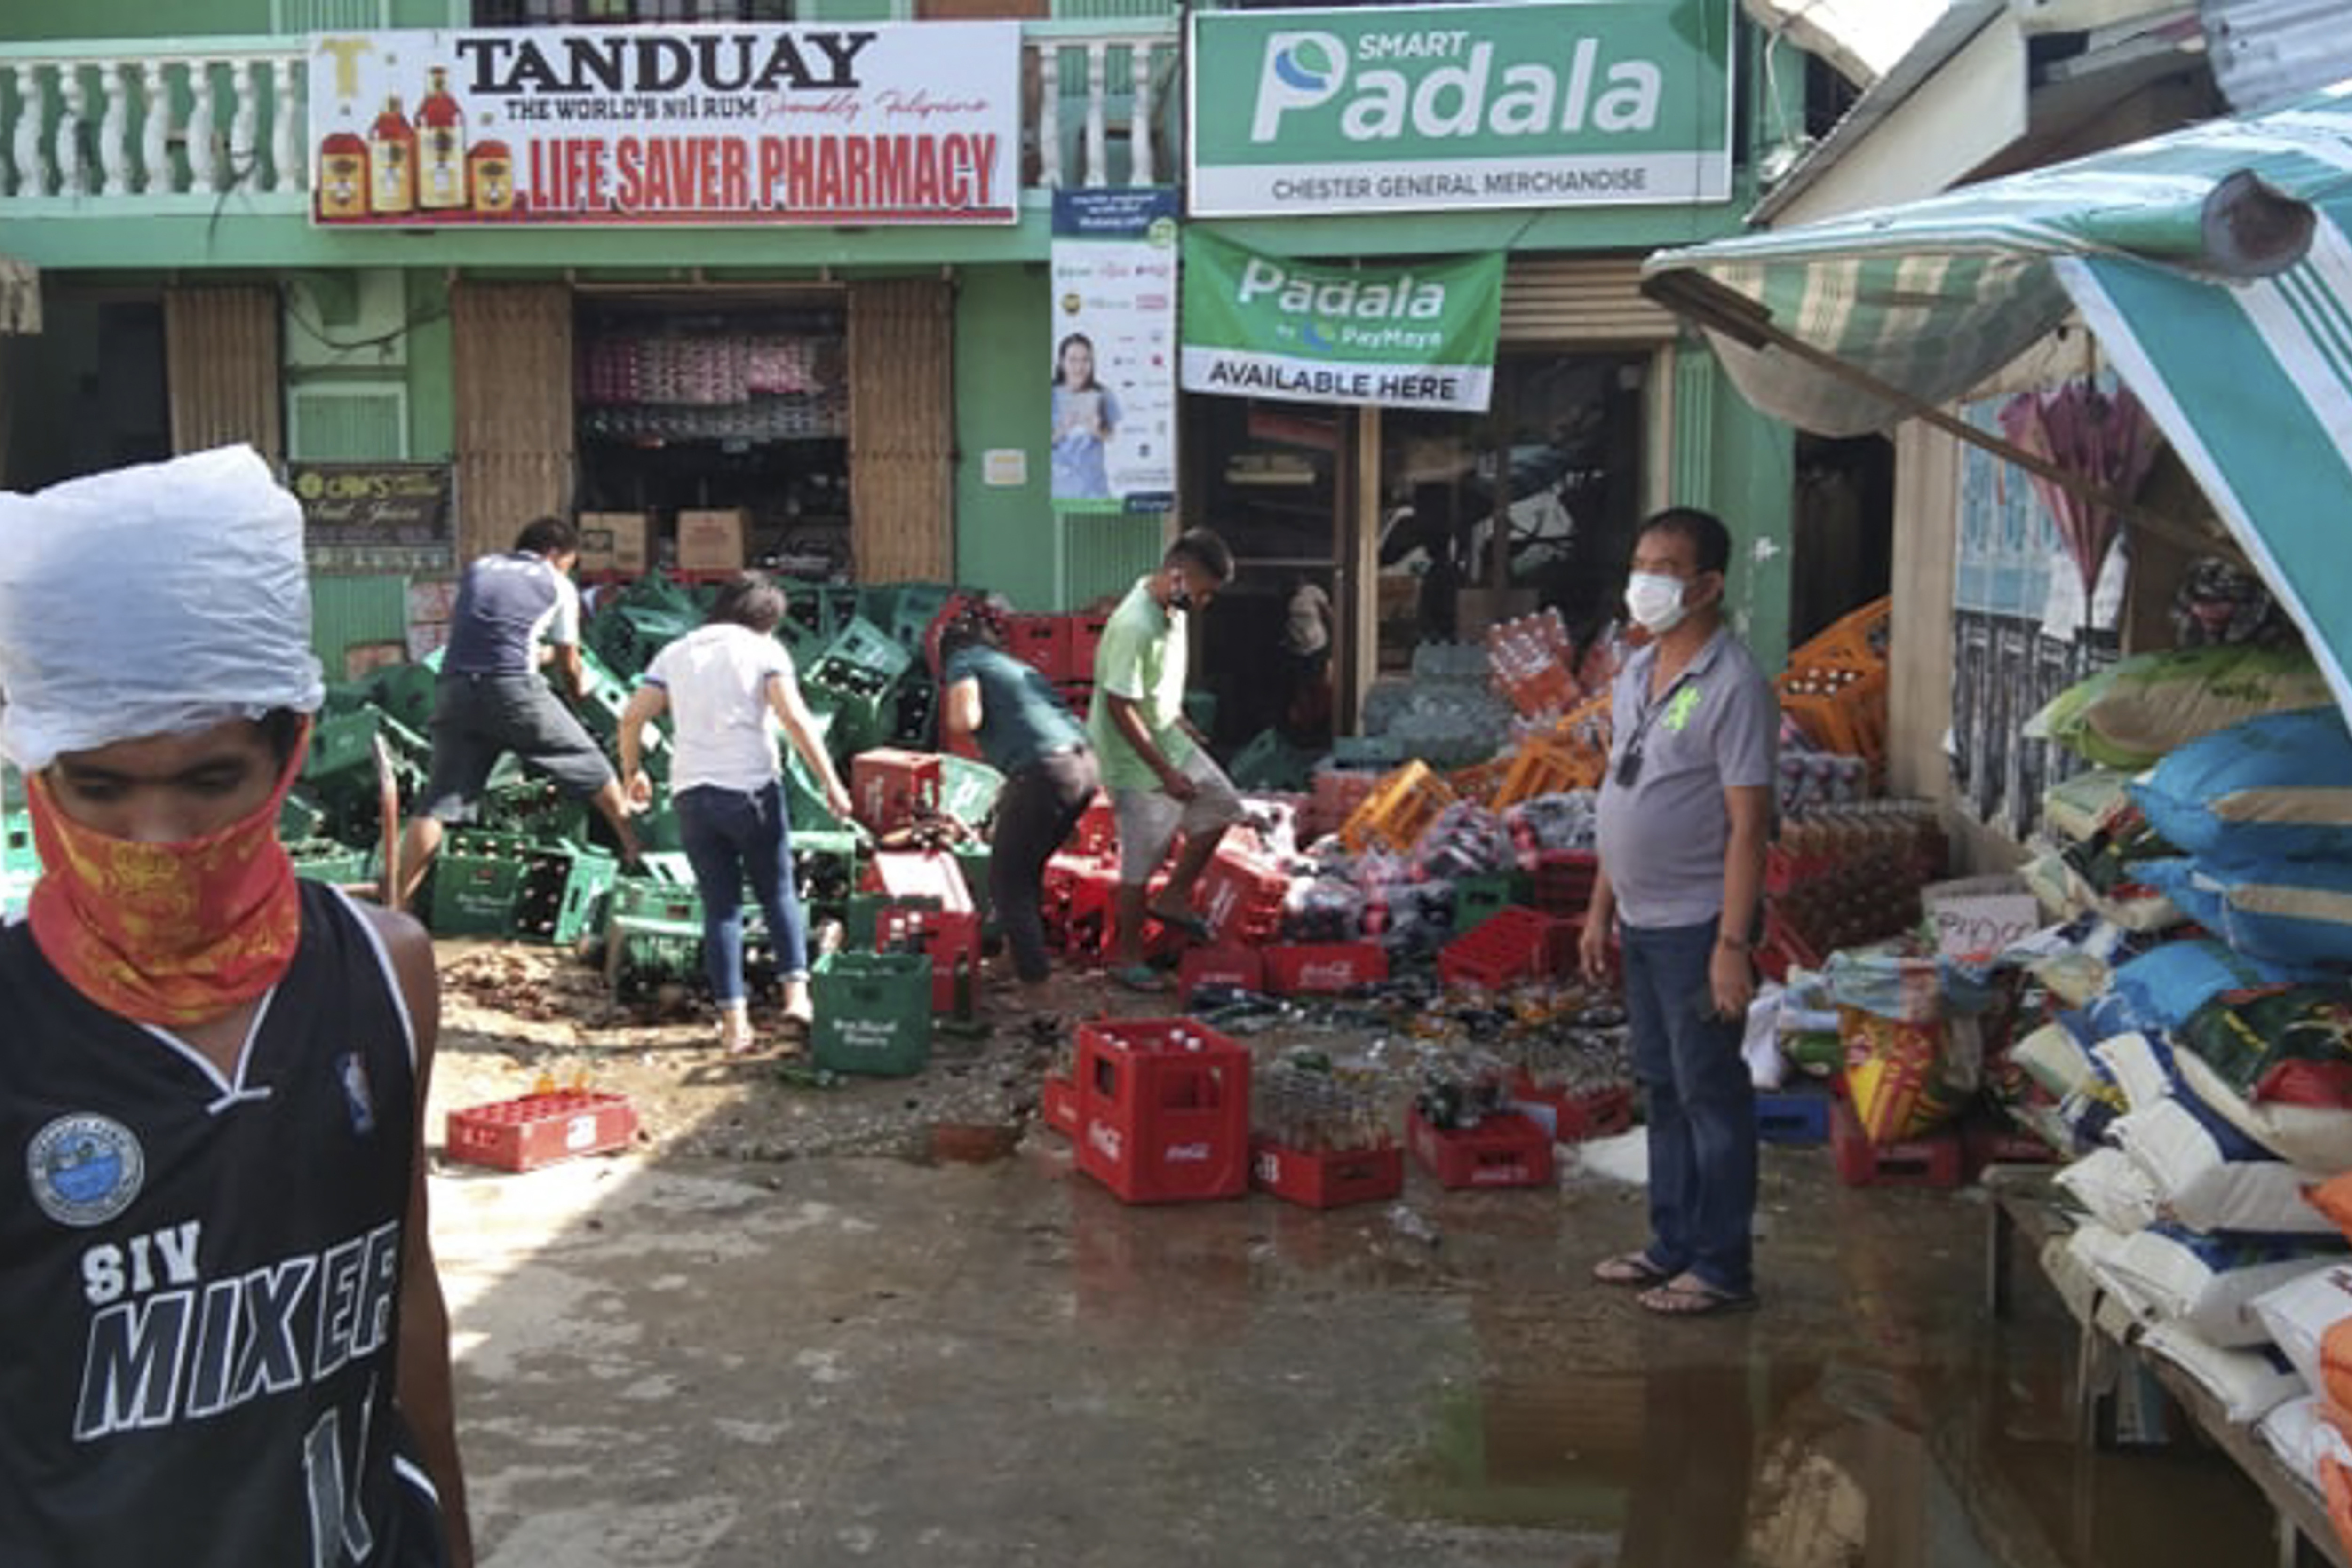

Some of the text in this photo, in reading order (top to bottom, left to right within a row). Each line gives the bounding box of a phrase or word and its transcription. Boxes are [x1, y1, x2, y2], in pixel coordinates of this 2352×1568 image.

[455, 32, 877, 93] TANDUAY
[1358, 30, 1469, 60] SMART
[505, 97, 549, 120] THE
[555, 96, 657, 120] WORLD'S
[702, 95, 758, 119] RUM
[1250, 31, 1663, 143] Padala
[529, 132, 996, 212] LIFE SAVER PHARMACY
[1271, 168, 1646, 201] CHESTER GENERAL MERCHANDISE
[1238, 257, 1446, 319] Padala
[1208, 360, 1459, 402] AVAILABLE HERE
